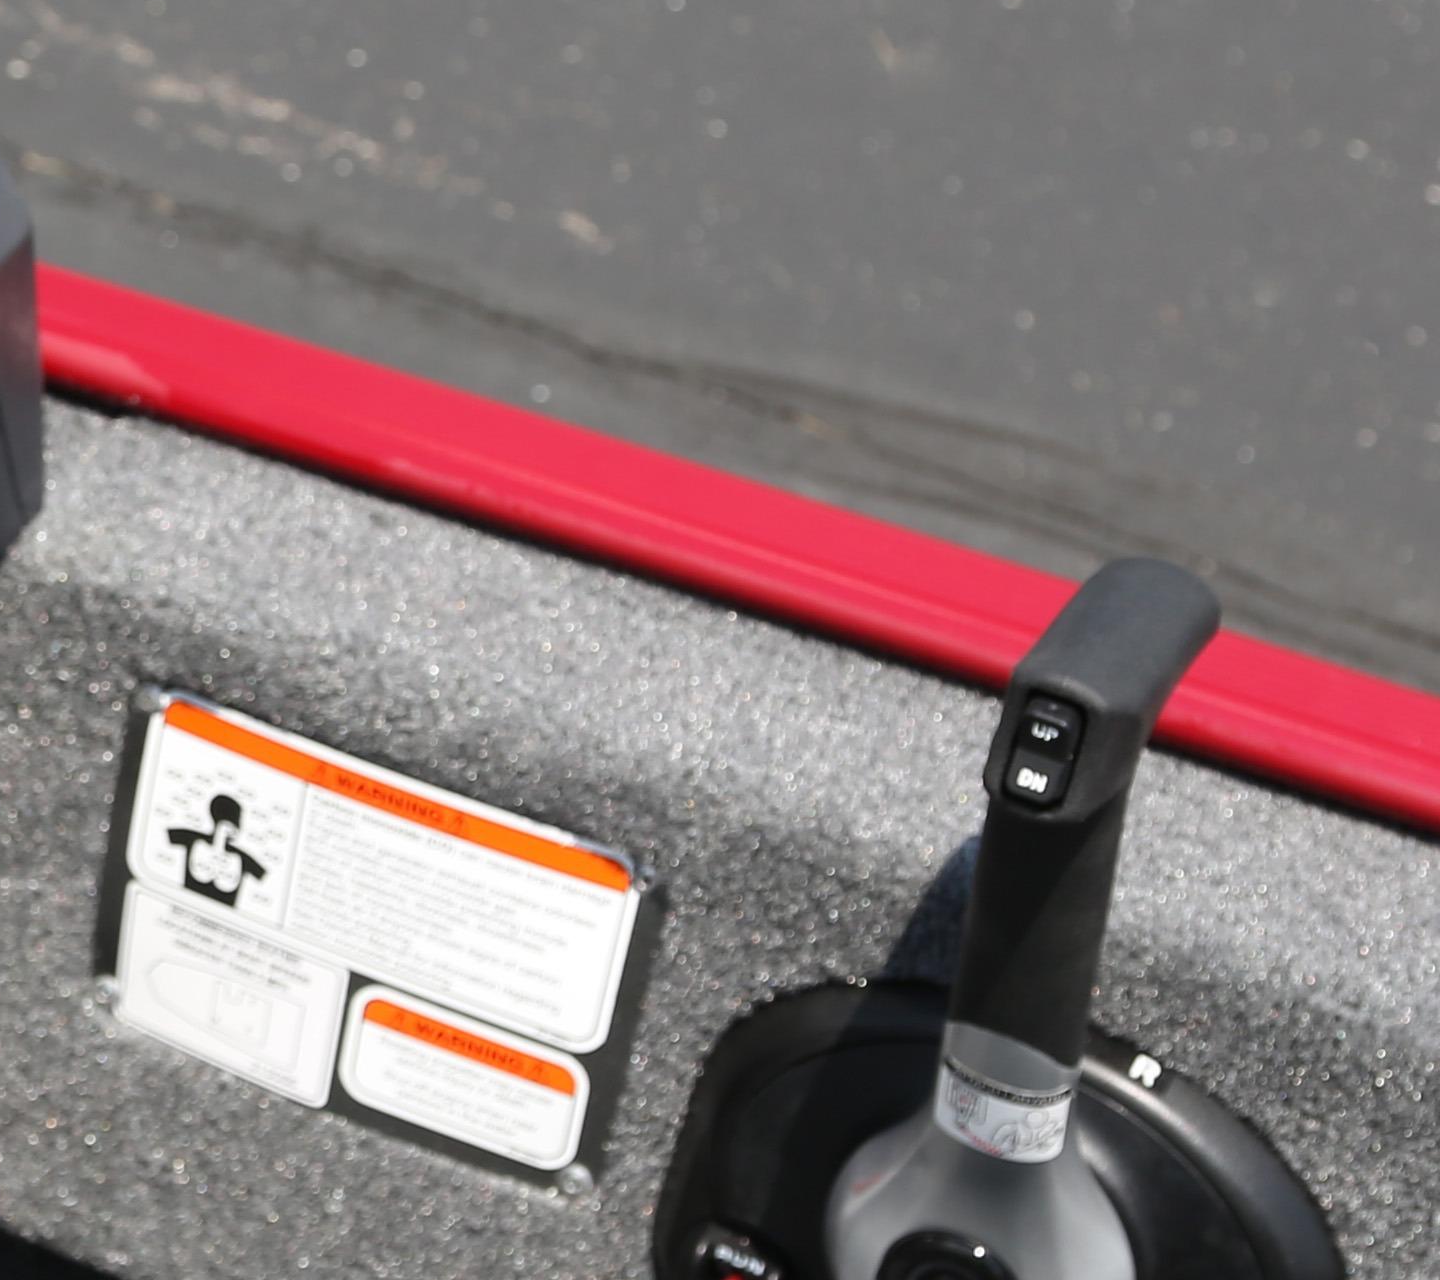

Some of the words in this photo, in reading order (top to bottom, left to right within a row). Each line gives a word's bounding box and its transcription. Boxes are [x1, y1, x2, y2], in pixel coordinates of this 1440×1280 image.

[1030, 721, 1060, 742] UP
[1015, 766, 1049, 794] DN
[1128, 1053, 1162, 1089] R
